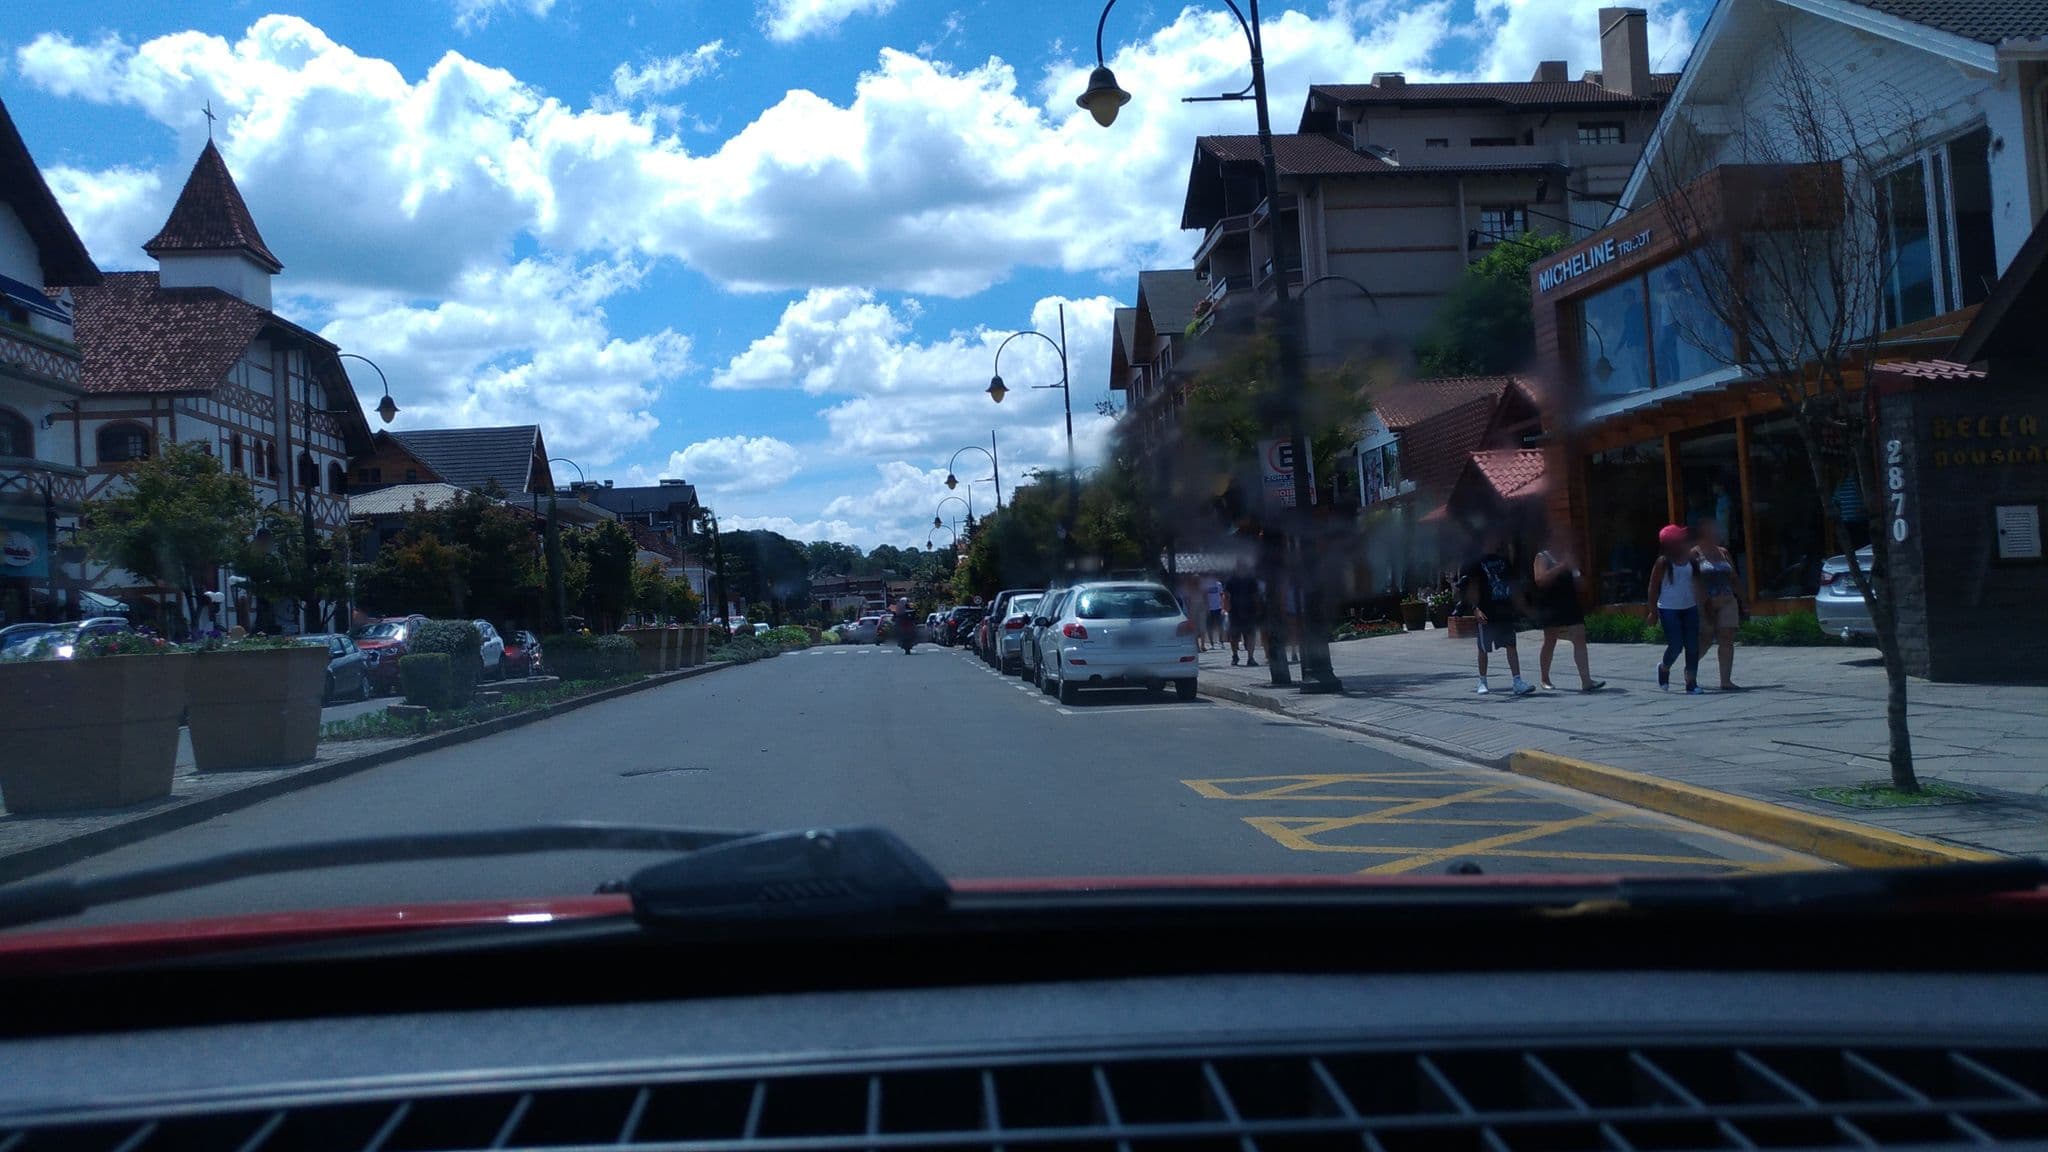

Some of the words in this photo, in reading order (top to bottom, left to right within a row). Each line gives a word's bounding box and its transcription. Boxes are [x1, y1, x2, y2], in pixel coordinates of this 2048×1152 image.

[1538, 239, 1616, 292] MICHELINE
[1617, 230, 1652, 255] TRICOT
[1279, 446, 1295, 467] E
[1887, 440, 1907, 542] 2870
